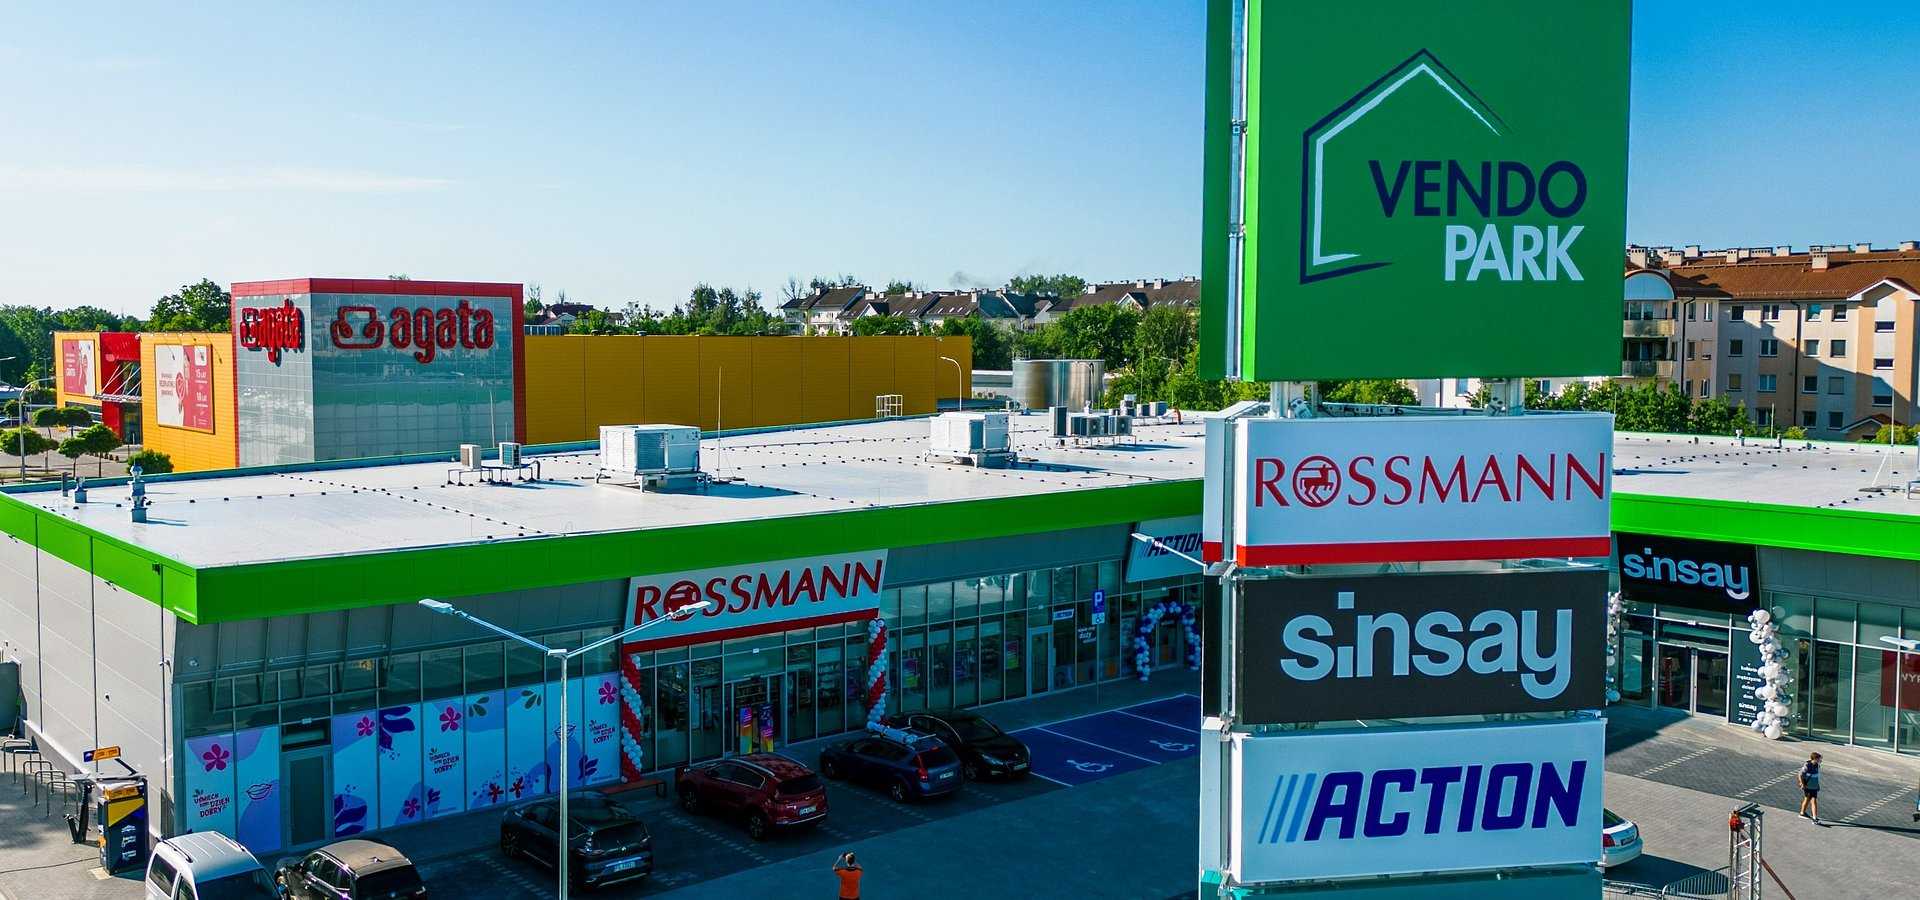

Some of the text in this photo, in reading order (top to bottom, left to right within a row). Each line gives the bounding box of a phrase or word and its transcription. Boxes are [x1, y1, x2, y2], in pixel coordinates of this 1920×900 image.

[1368, 160, 1587, 218] VENDO
[1444, 224, 1585, 281] PARK
[390, 299, 494, 364] agata
[1255, 452, 1605, 508] ROSSMANN
[633, 559, 883, 626] ROSSMANN
[1094, 591, 1103, 607] P
[1623, 547, 1750, 600] sinsay
[1280, 591, 1573, 700] sinsay
[199, 806, 222, 818] DOBRY
[1304, 760, 1588, 841] ACTION
